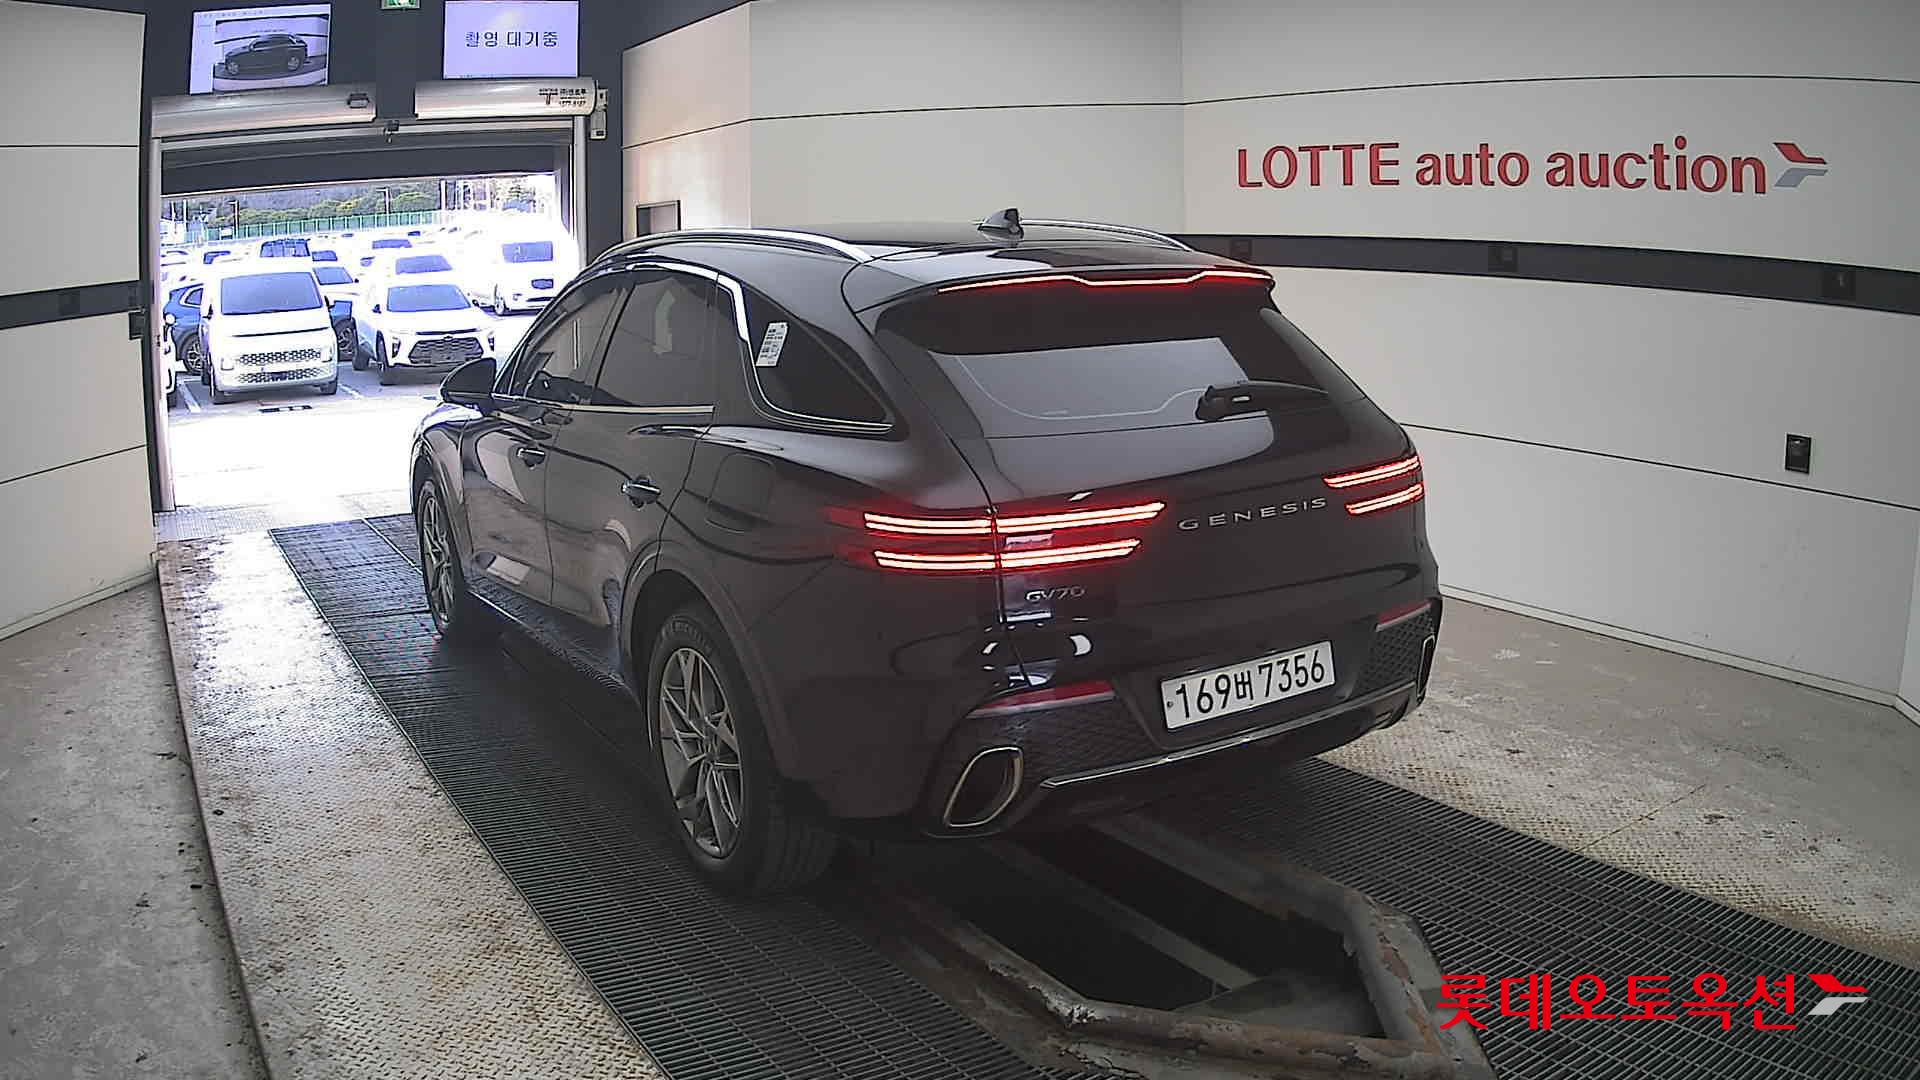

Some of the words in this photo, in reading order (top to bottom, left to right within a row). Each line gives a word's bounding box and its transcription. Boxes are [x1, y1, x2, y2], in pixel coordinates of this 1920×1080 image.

[506, 31, 559, 48] 대기중
[1237, 142, 1400, 188] LOTTE
[1415, 143, 1529, 187] auto
[1545, 135, 1766, 194] auction
[1178, 497, 1327, 531] GENESIS
[1025, 585, 1086, 602] GV70
[1175, 668, 1254, 719] 169버
[1257, 649, 1326, 698] 7356
